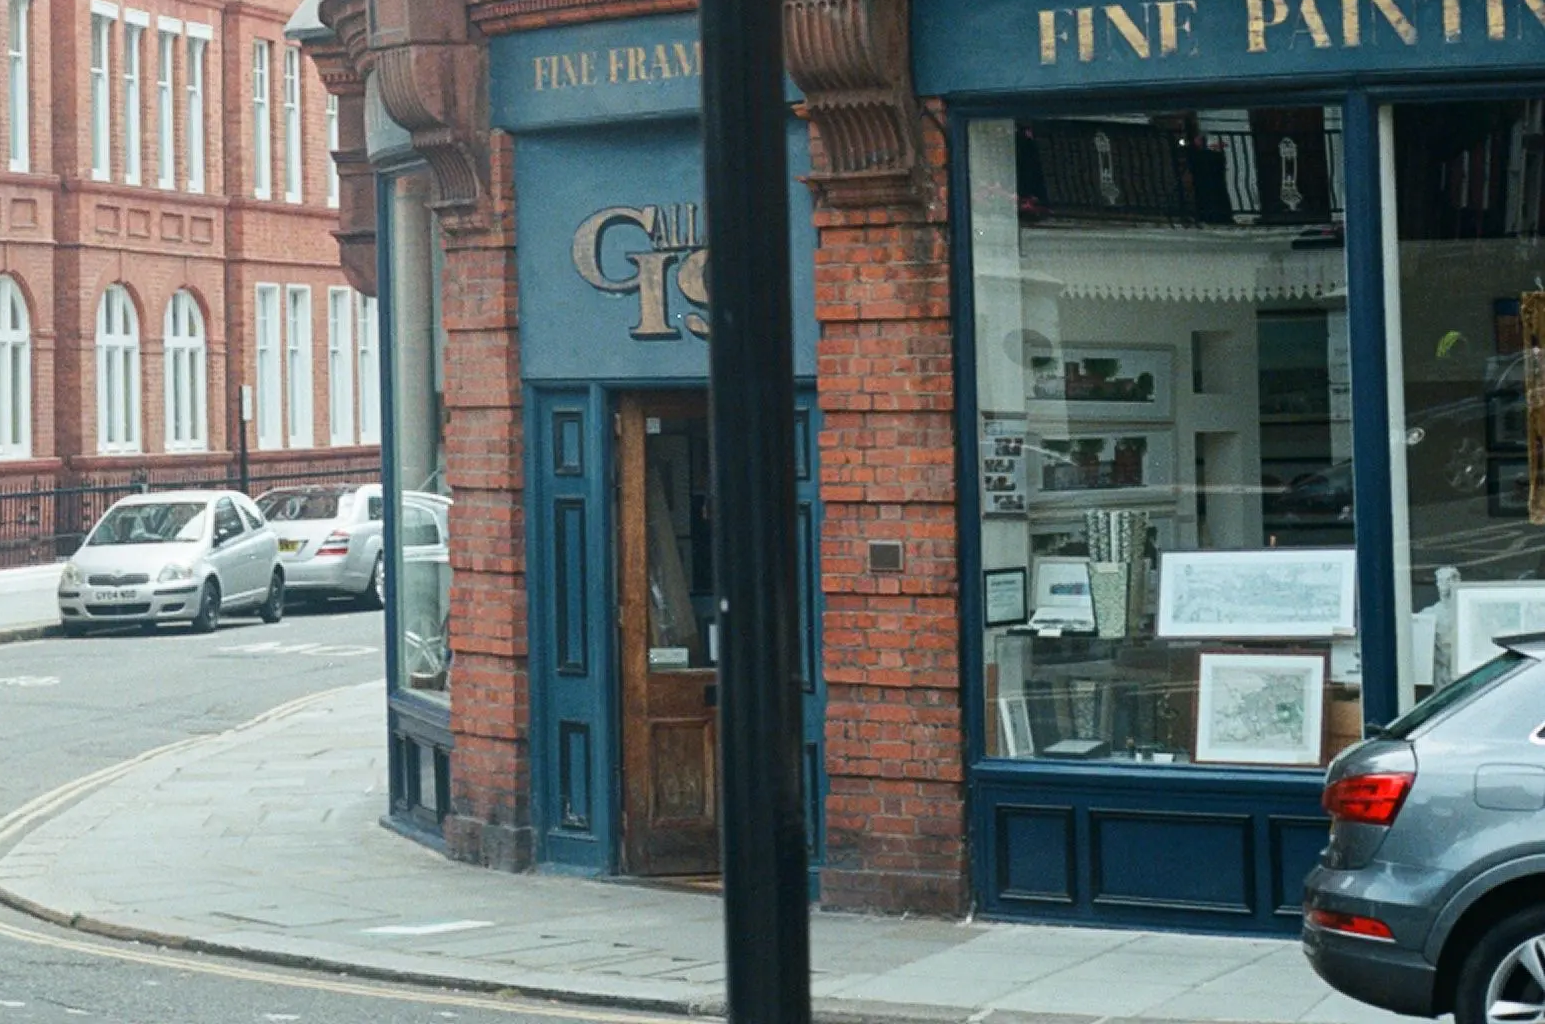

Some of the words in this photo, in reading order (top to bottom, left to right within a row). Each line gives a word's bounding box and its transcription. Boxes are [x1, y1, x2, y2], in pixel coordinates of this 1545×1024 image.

[1038, 0, 1198, 66] FINE
[533, 51, 598, 91] FINE
[608, 40, 703, 84] FRAM
